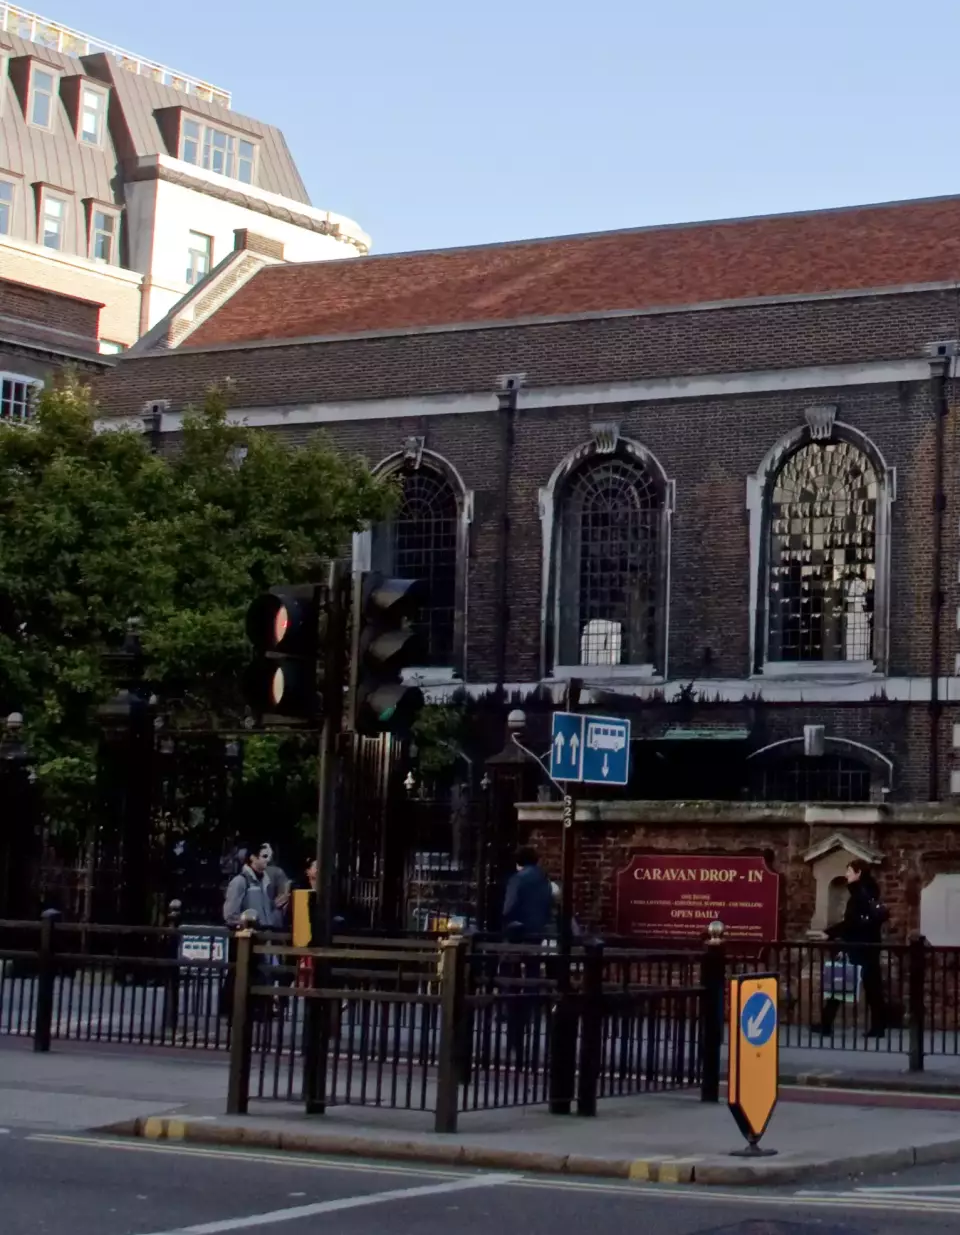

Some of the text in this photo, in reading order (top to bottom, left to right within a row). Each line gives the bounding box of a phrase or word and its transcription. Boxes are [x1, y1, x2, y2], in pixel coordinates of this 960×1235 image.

[633, 868, 697, 881] CARAVAN
[700, 869, 738, 882] DROP
[748, 870, 764, 882] IN
[670, 910, 720, 919] OPEN DAILY
